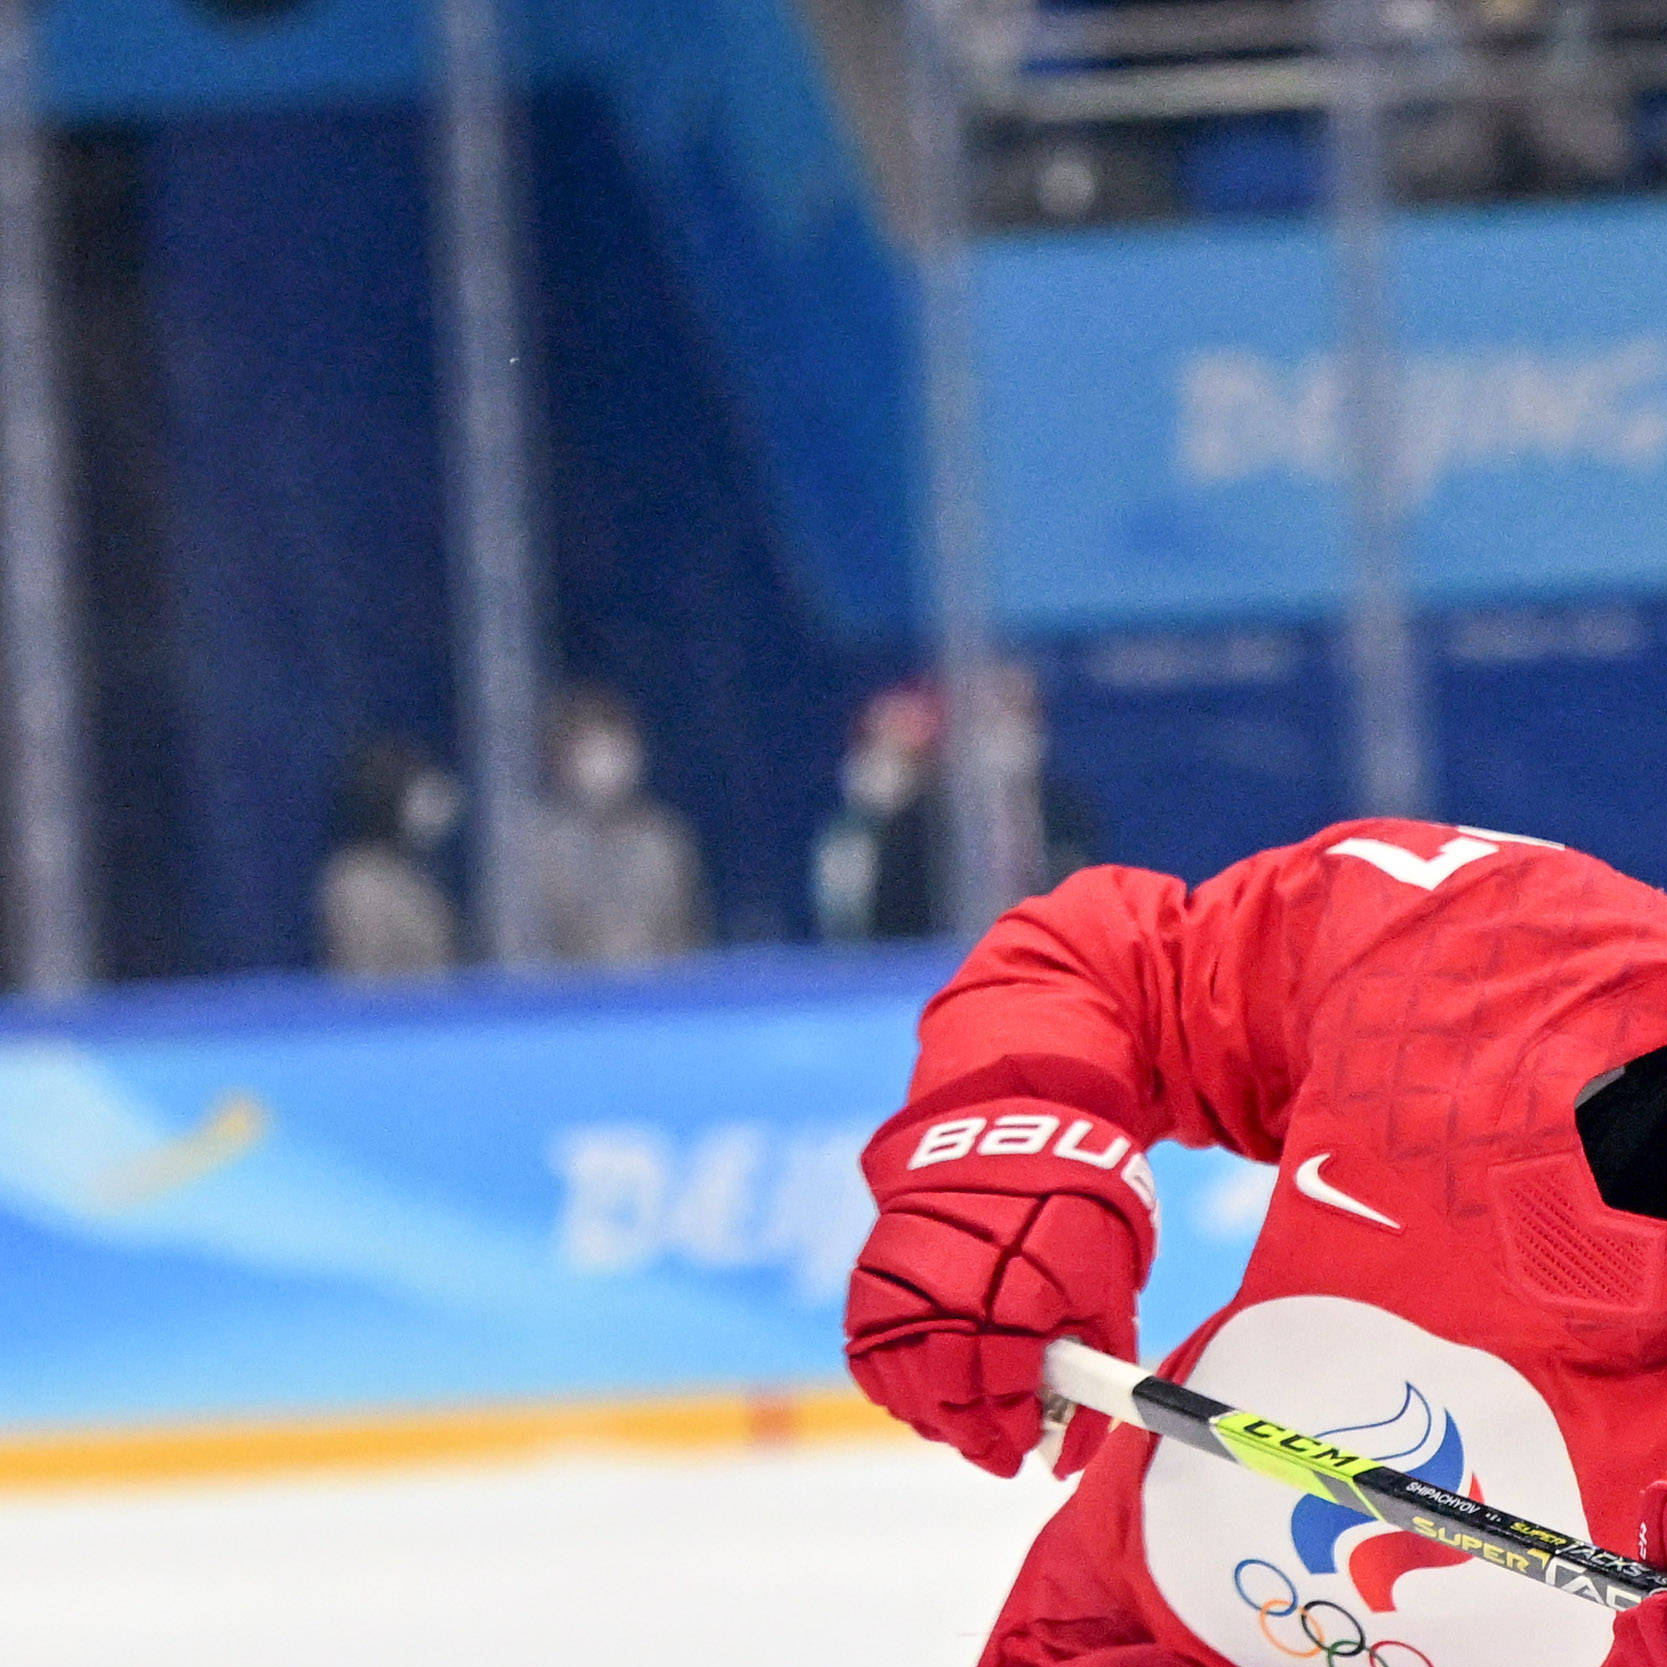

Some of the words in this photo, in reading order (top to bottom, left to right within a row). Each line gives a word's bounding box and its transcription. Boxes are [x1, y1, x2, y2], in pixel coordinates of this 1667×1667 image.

[1243, 1418, 1360, 1468] CCM
[1405, 1480, 1481, 1515] SHIPACHYOV
[1510, 1521, 1567, 1546] SUPER
[1411, 1515, 1531, 1574] SUPER
[1543, 1549, 1650, 1612] TAC
